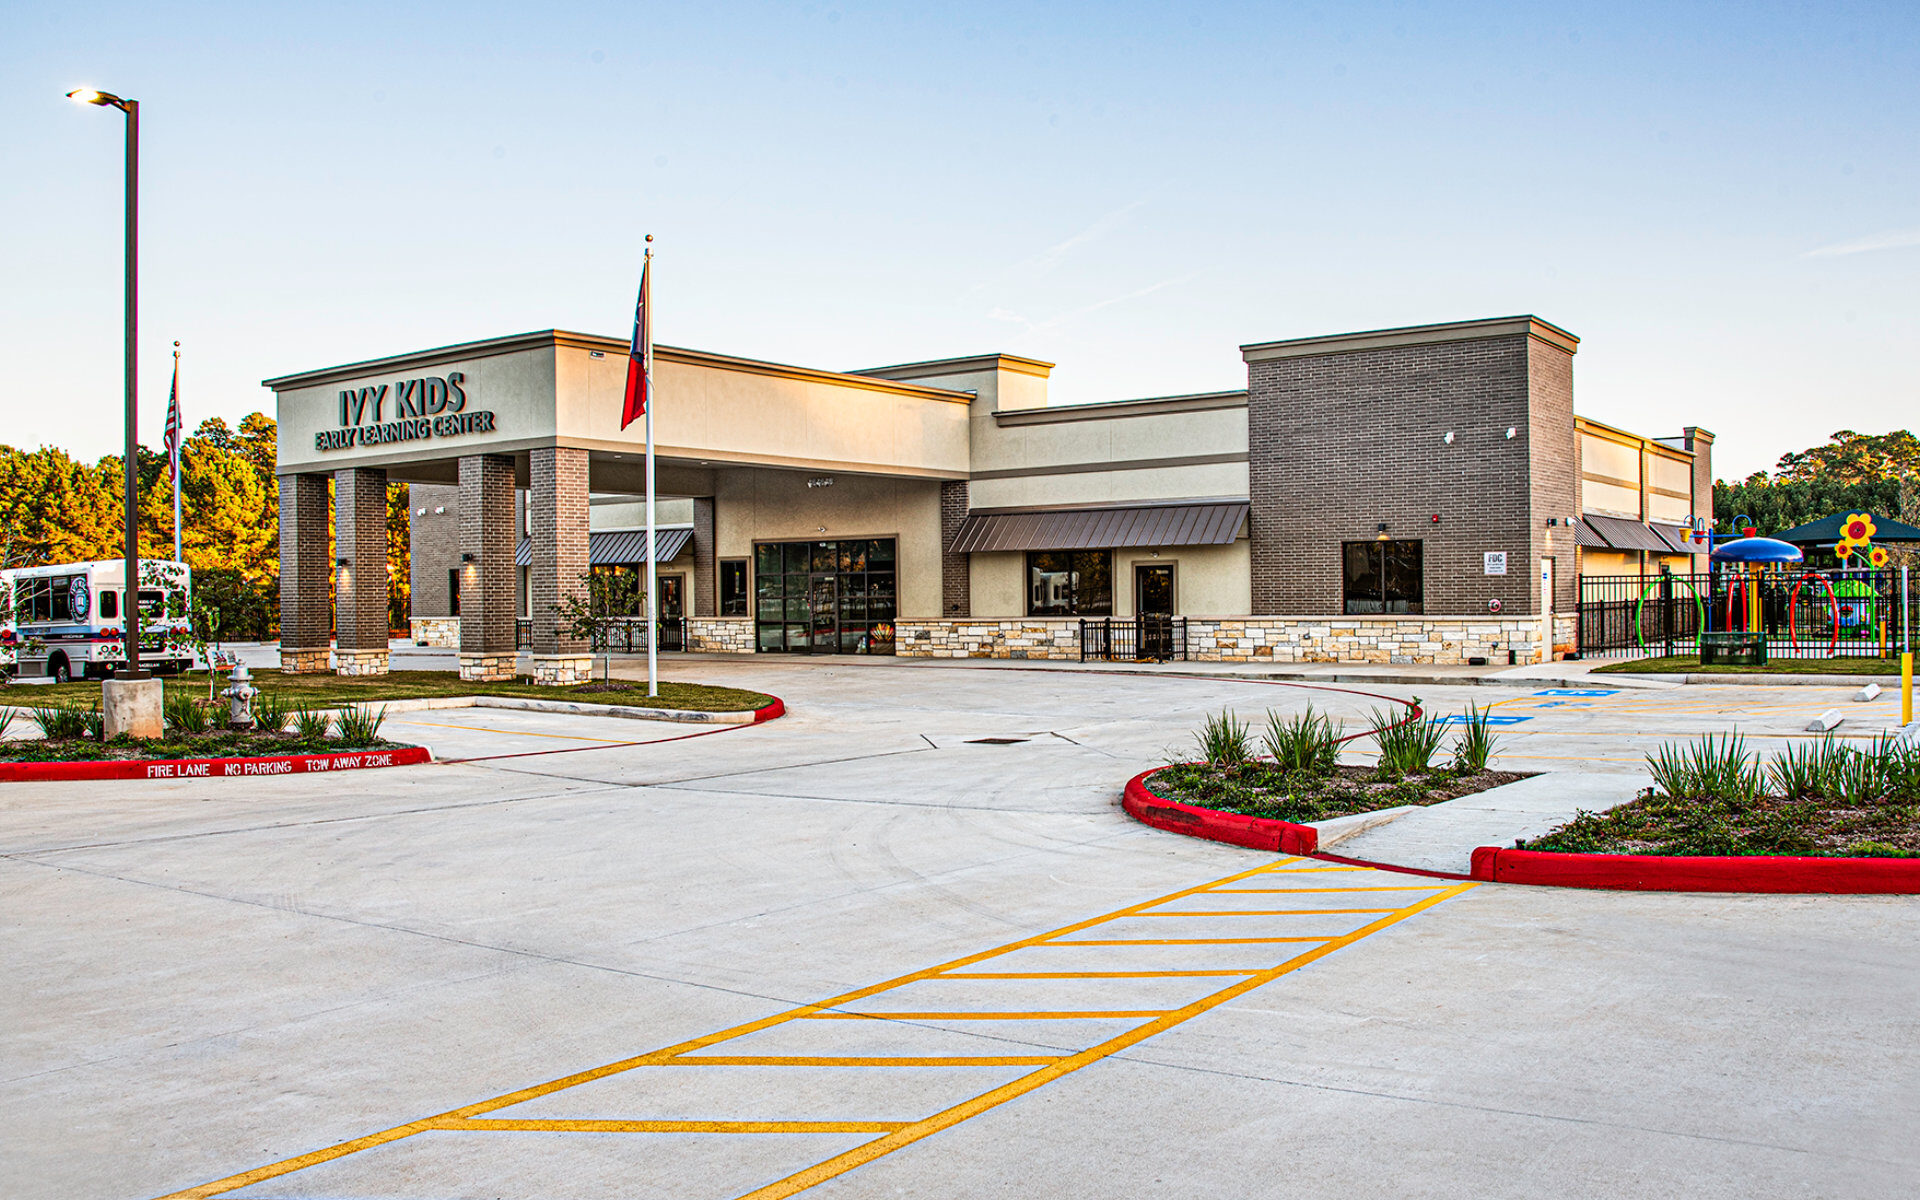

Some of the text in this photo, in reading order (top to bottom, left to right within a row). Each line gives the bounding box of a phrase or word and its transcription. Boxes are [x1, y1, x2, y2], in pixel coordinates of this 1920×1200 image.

[339, 372, 466, 426] IVY KIDS
[315, 411, 495, 451] EARLY LEARNING CENTER
[147, 753, 393, 778] FIRE LANE NO PARKING TOW AWAY ZONE
